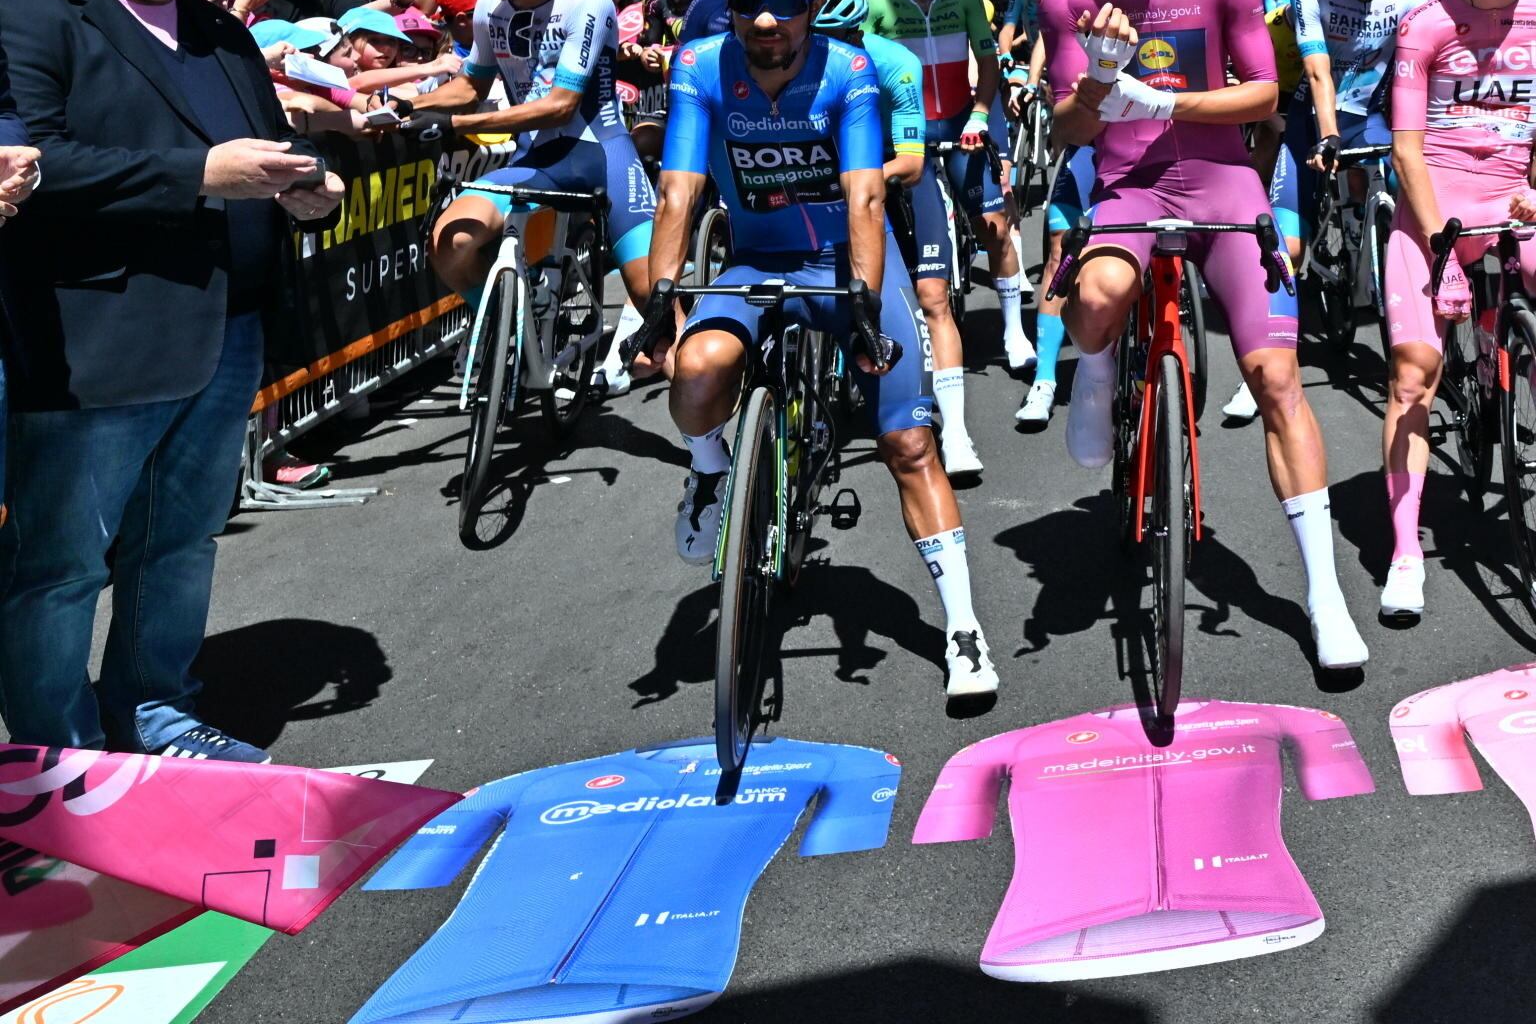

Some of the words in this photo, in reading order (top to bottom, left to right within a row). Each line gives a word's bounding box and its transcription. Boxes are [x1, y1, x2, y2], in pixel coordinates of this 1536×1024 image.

[1329, 12, 1398, 31] BAHRAIN
[489, 23, 568, 43] BAAIN
[577, 13, 596, 69] MERIDA
[598, 56, 618, 128] BAHRAIN
[1453, 79, 1534, 104] UAE
[1449, 103, 1528, 122] Emirates
[728, 112, 831, 137] mediolanum
[732, 144, 832, 170] BORA
[628, 166, 636, 203] BUSINESS
[741, 167, 833, 186] hansgrohe
[1236, 717, 1260, 725] Sport
[783, 762, 812, 771] Sport
[1043, 743, 1257, 774] madeinitaly.gov.it
[540, 791, 785, 825] mediolaum
[1224, 852, 1270, 864] ITALIA.IT
[671, 910, 721, 920] ITALIA.IT
